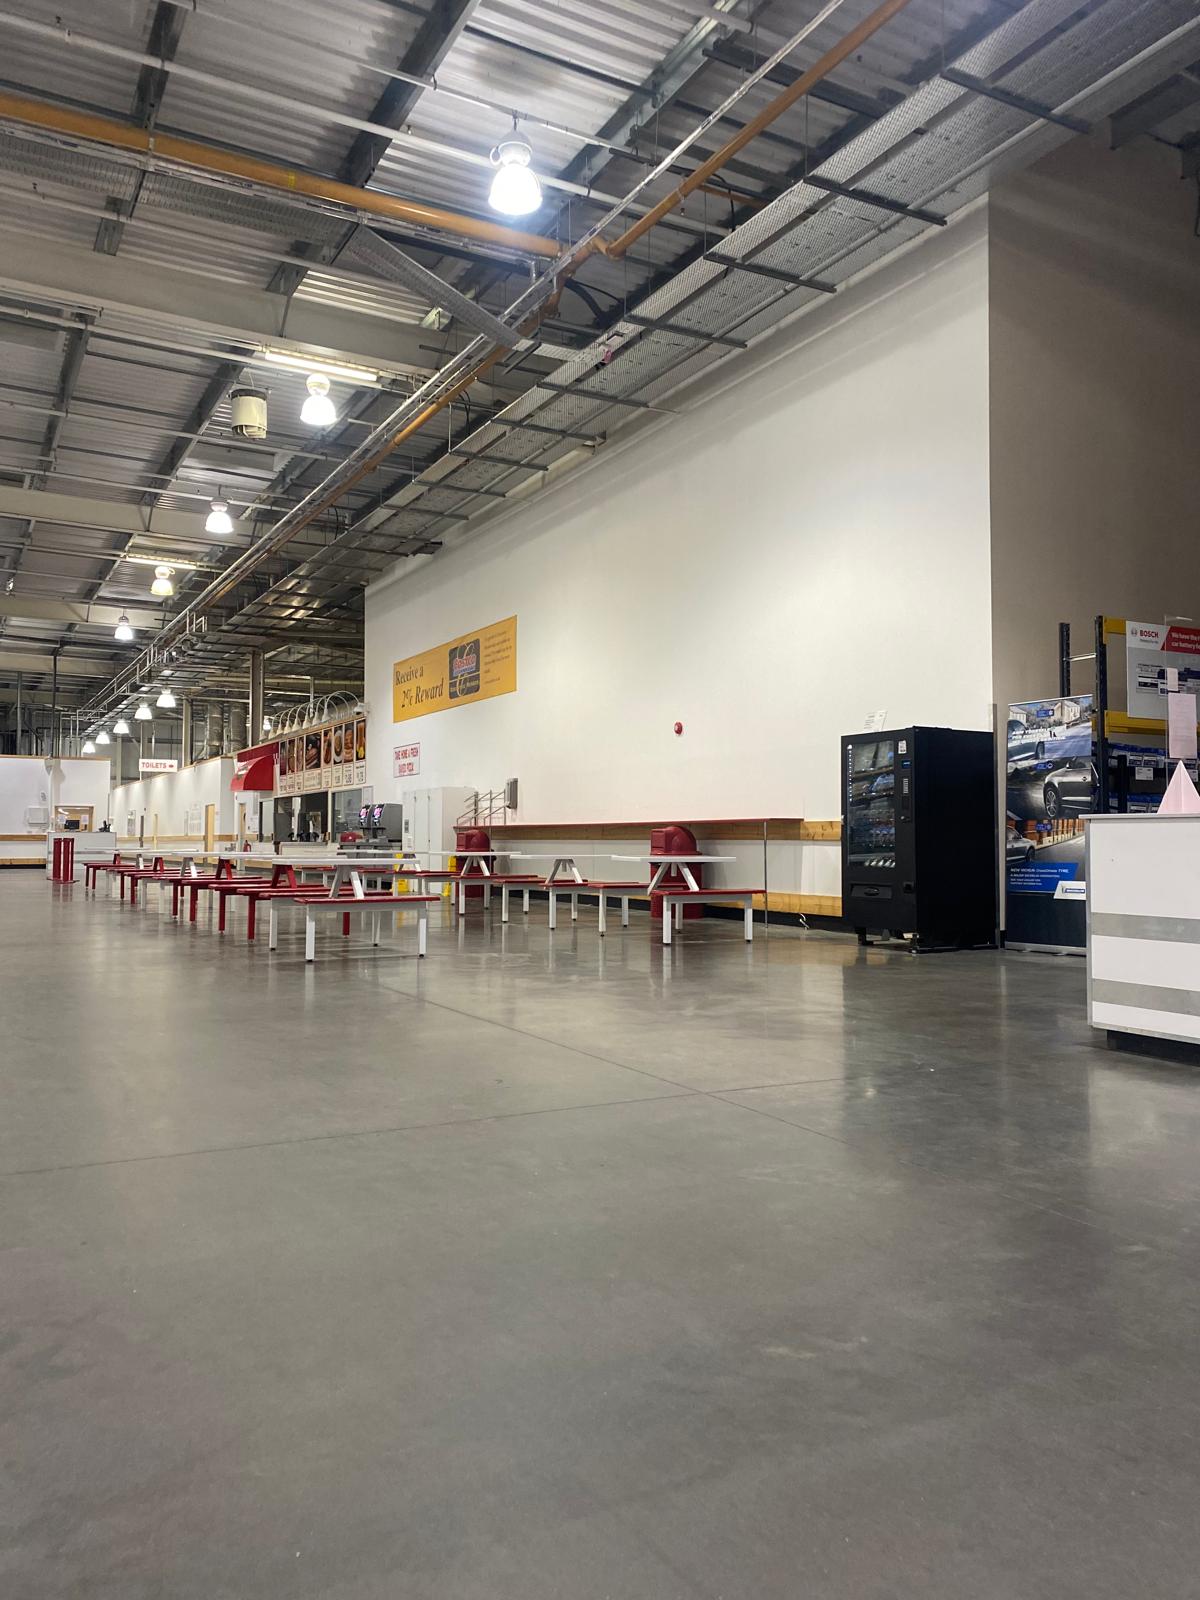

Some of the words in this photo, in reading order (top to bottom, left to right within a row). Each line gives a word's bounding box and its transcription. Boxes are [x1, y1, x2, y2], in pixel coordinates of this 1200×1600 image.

[1139, 630, 1159, 638] BOSCH
[395, 666, 418, 686] Receive
[419, 665, 424, 678] a
[414, 676, 444, 705] Reward
